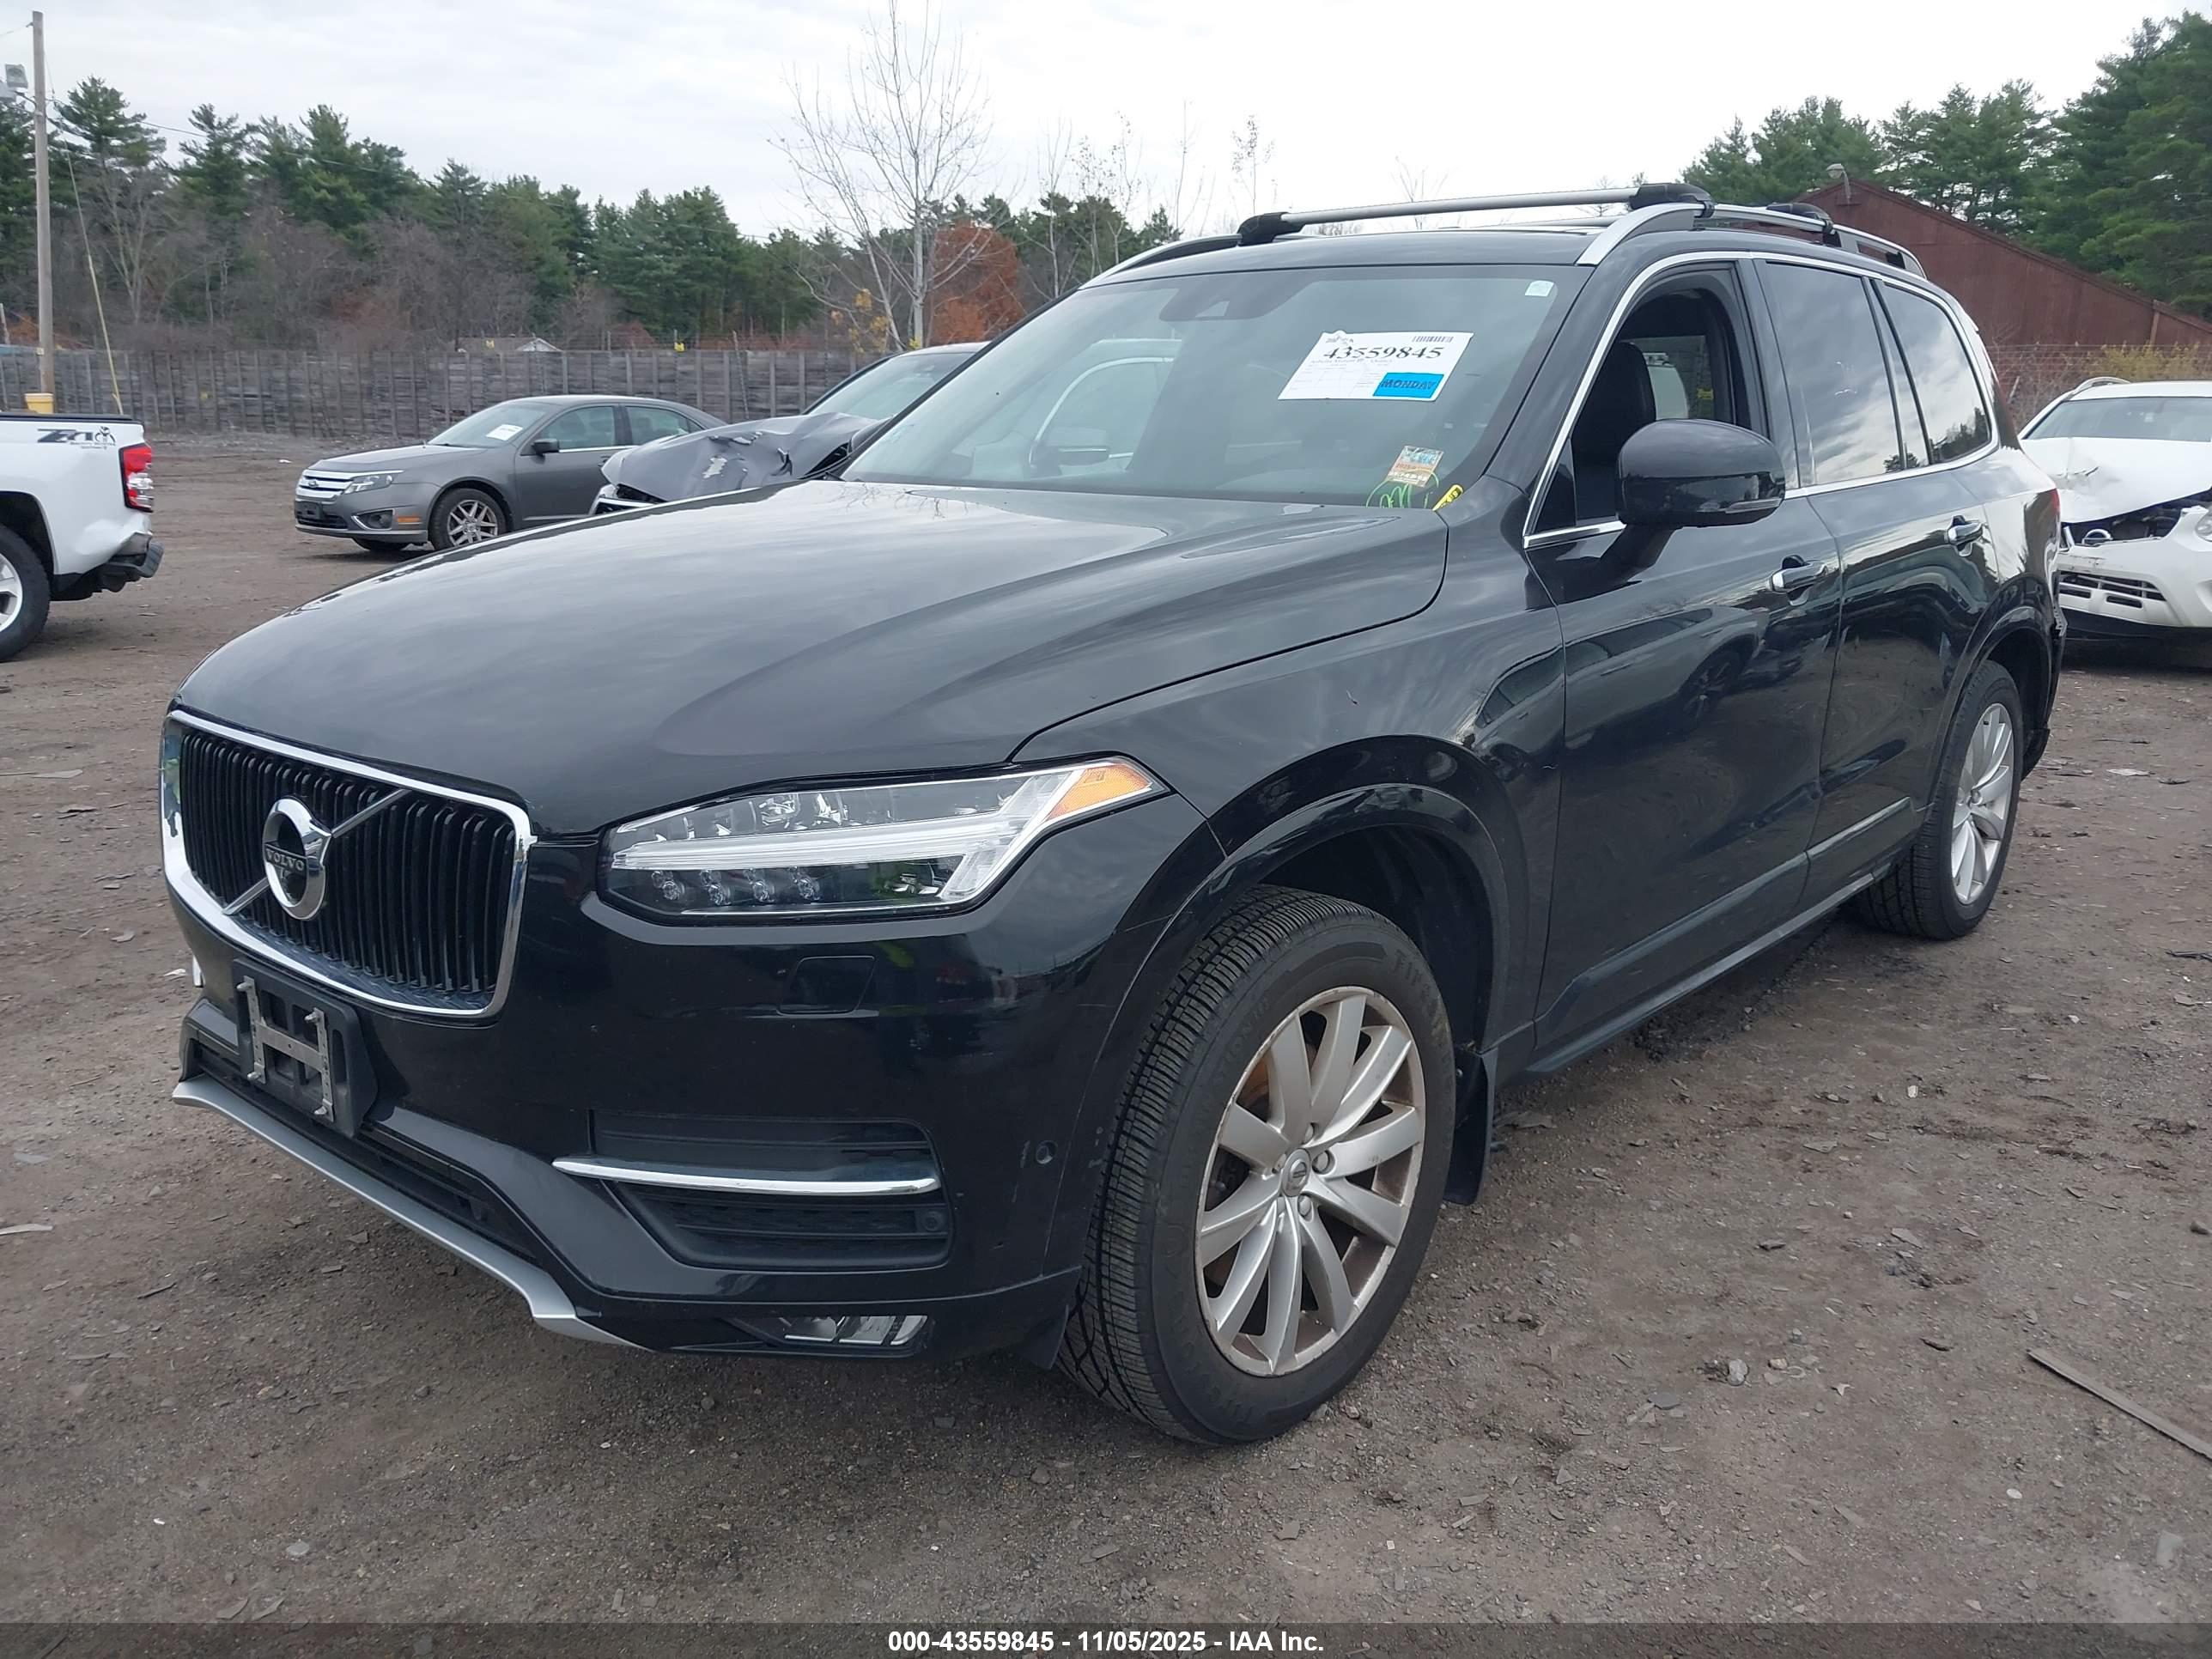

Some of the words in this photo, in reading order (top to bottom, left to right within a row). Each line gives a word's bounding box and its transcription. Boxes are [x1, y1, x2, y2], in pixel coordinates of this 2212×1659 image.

[1324, 346, 1444, 359] 43559845
[1381, 380, 1436, 390] MONDAY
[266, 848, 305, 871] VOLVO
